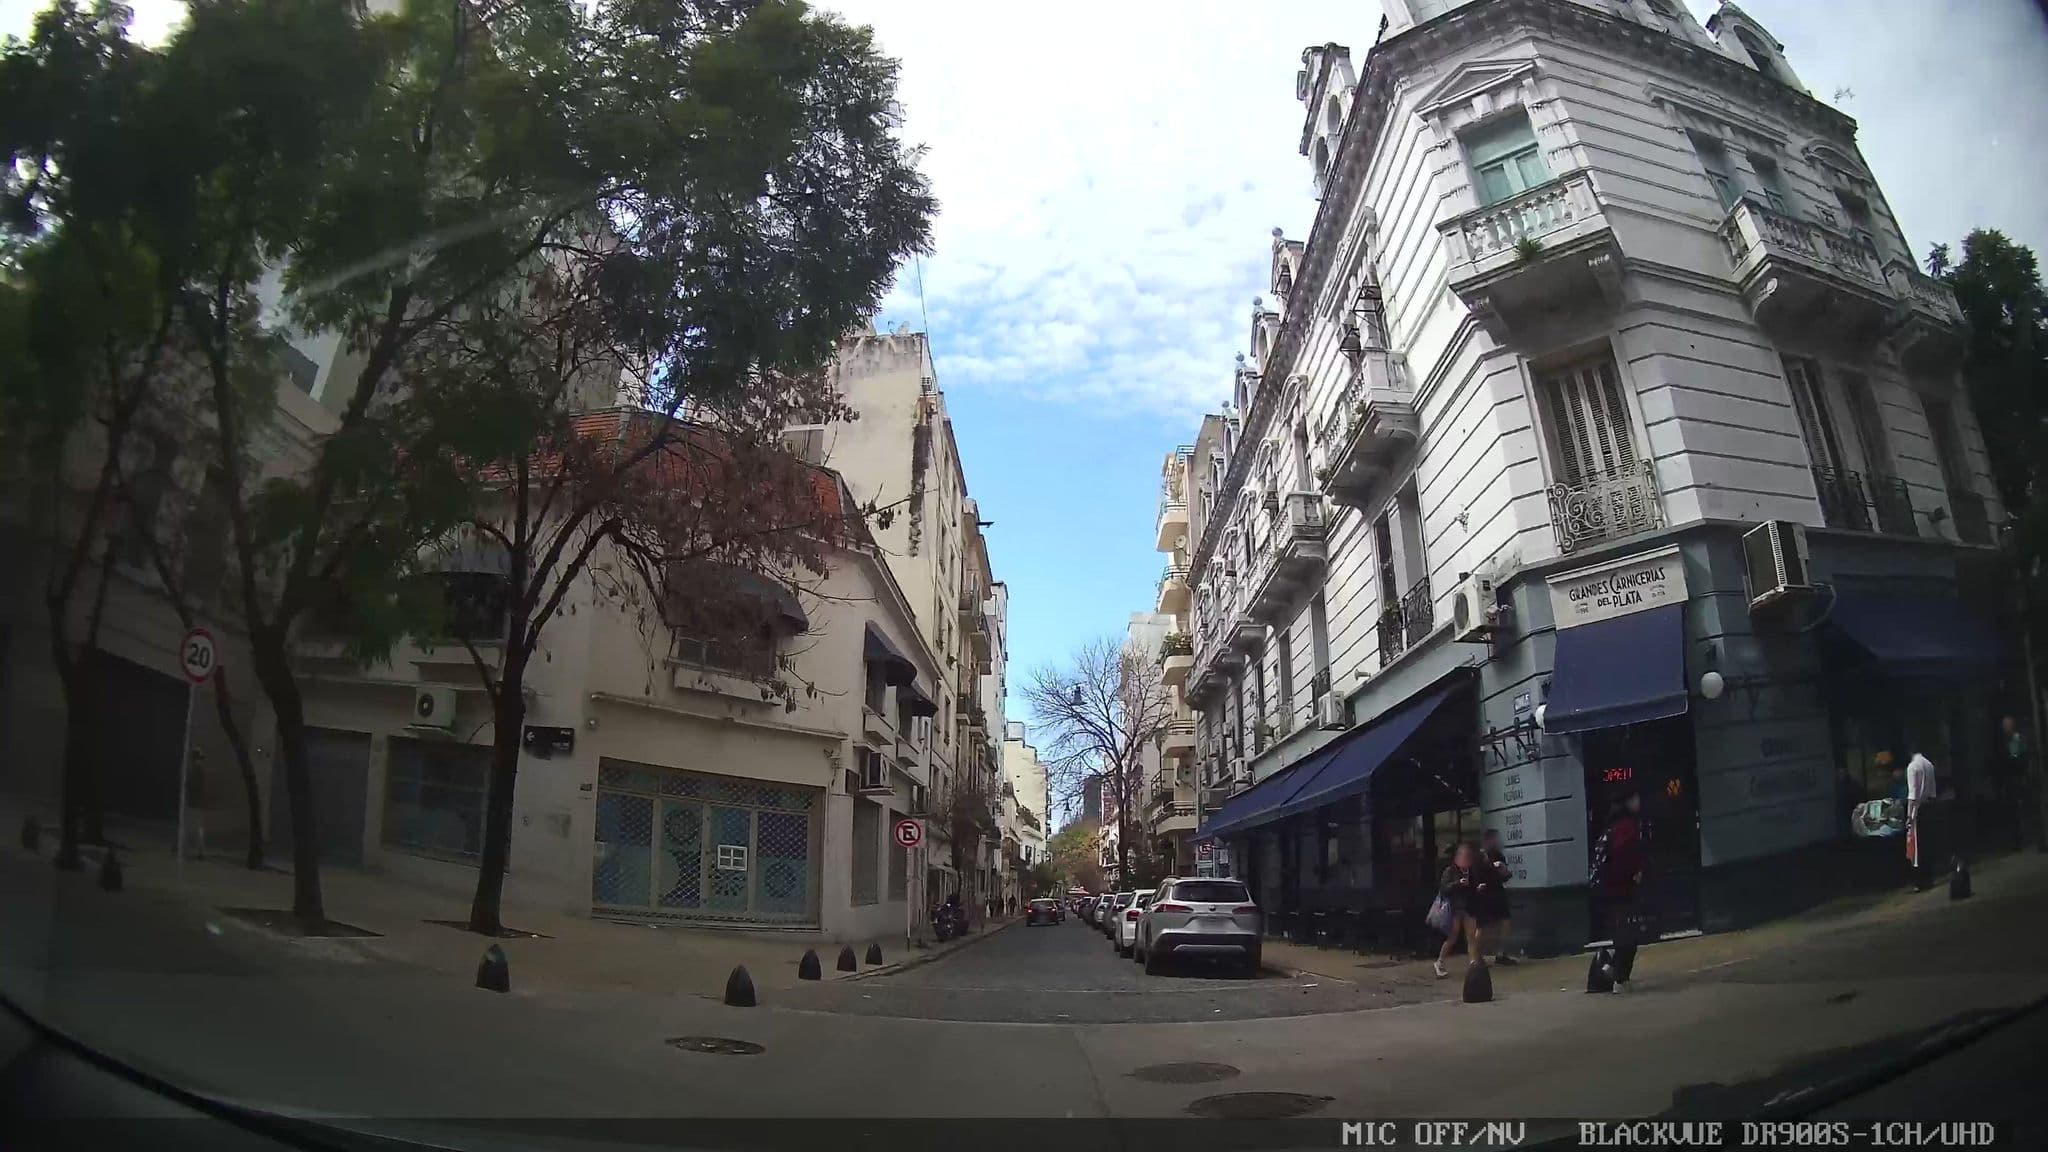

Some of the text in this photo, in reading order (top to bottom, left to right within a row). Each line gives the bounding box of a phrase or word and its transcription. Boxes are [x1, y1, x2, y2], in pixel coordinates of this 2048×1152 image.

[1569, 566, 1666, 602] GRANDES CARNICERIAS
[1597, 597, 1612, 608] DEL
[1612, 590, 1643, 608] PLATA
[187, 643, 210, 669] 20
